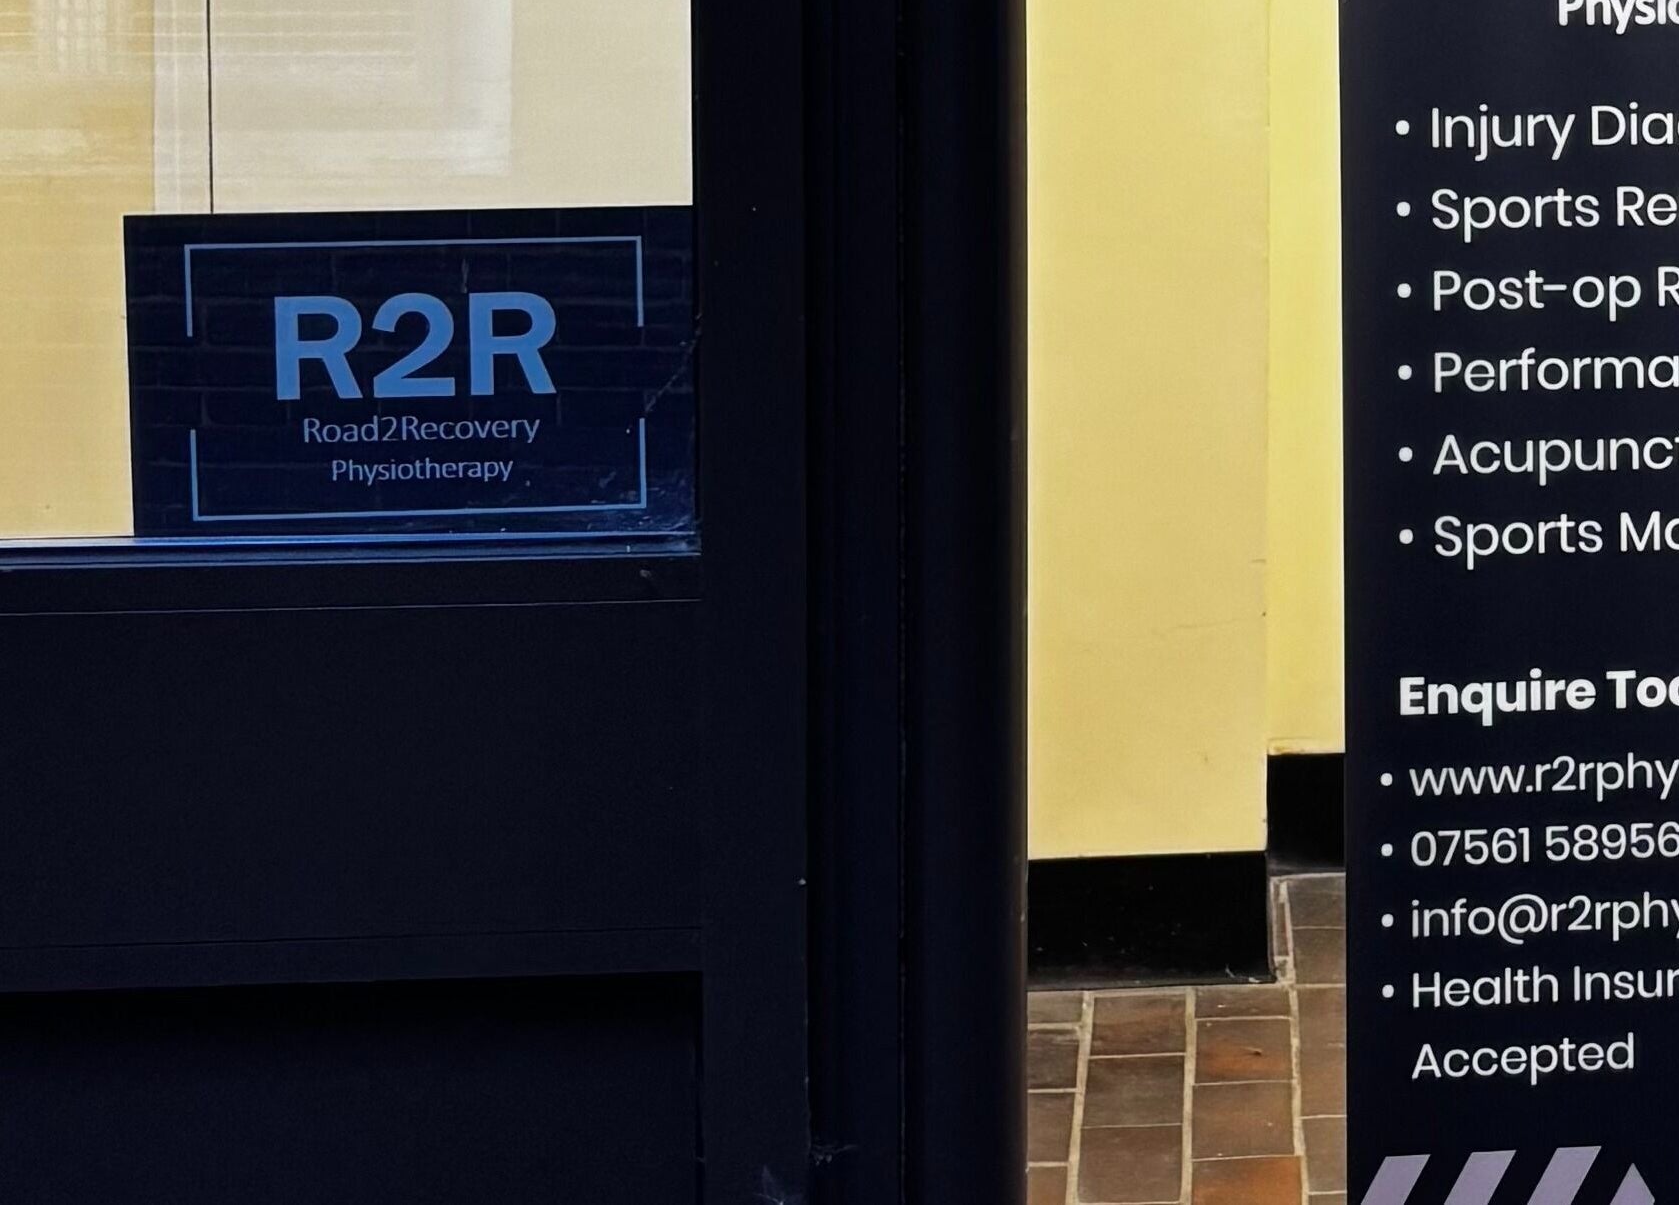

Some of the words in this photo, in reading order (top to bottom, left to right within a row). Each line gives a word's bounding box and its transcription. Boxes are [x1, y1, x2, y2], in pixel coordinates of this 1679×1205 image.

[1432, 104, 1575, 161] Injury
[1432, 188, 1599, 243] Sports
[1434, 270, 1641, 321] Post-op
[274, 292, 556, 400] R2R
[304, 416, 539, 443] Road2Recovery
[332, 458, 513, 485] Physiotherapy
[1435, 514, 1603, 570] Sports
[1400, 668, 1596, 726] Enquire
[1412, 828, 1529, 866] 07561
[1413, 966, 1558, 1007] Health
[1412, 1032, 1634, 1085] Accepted
